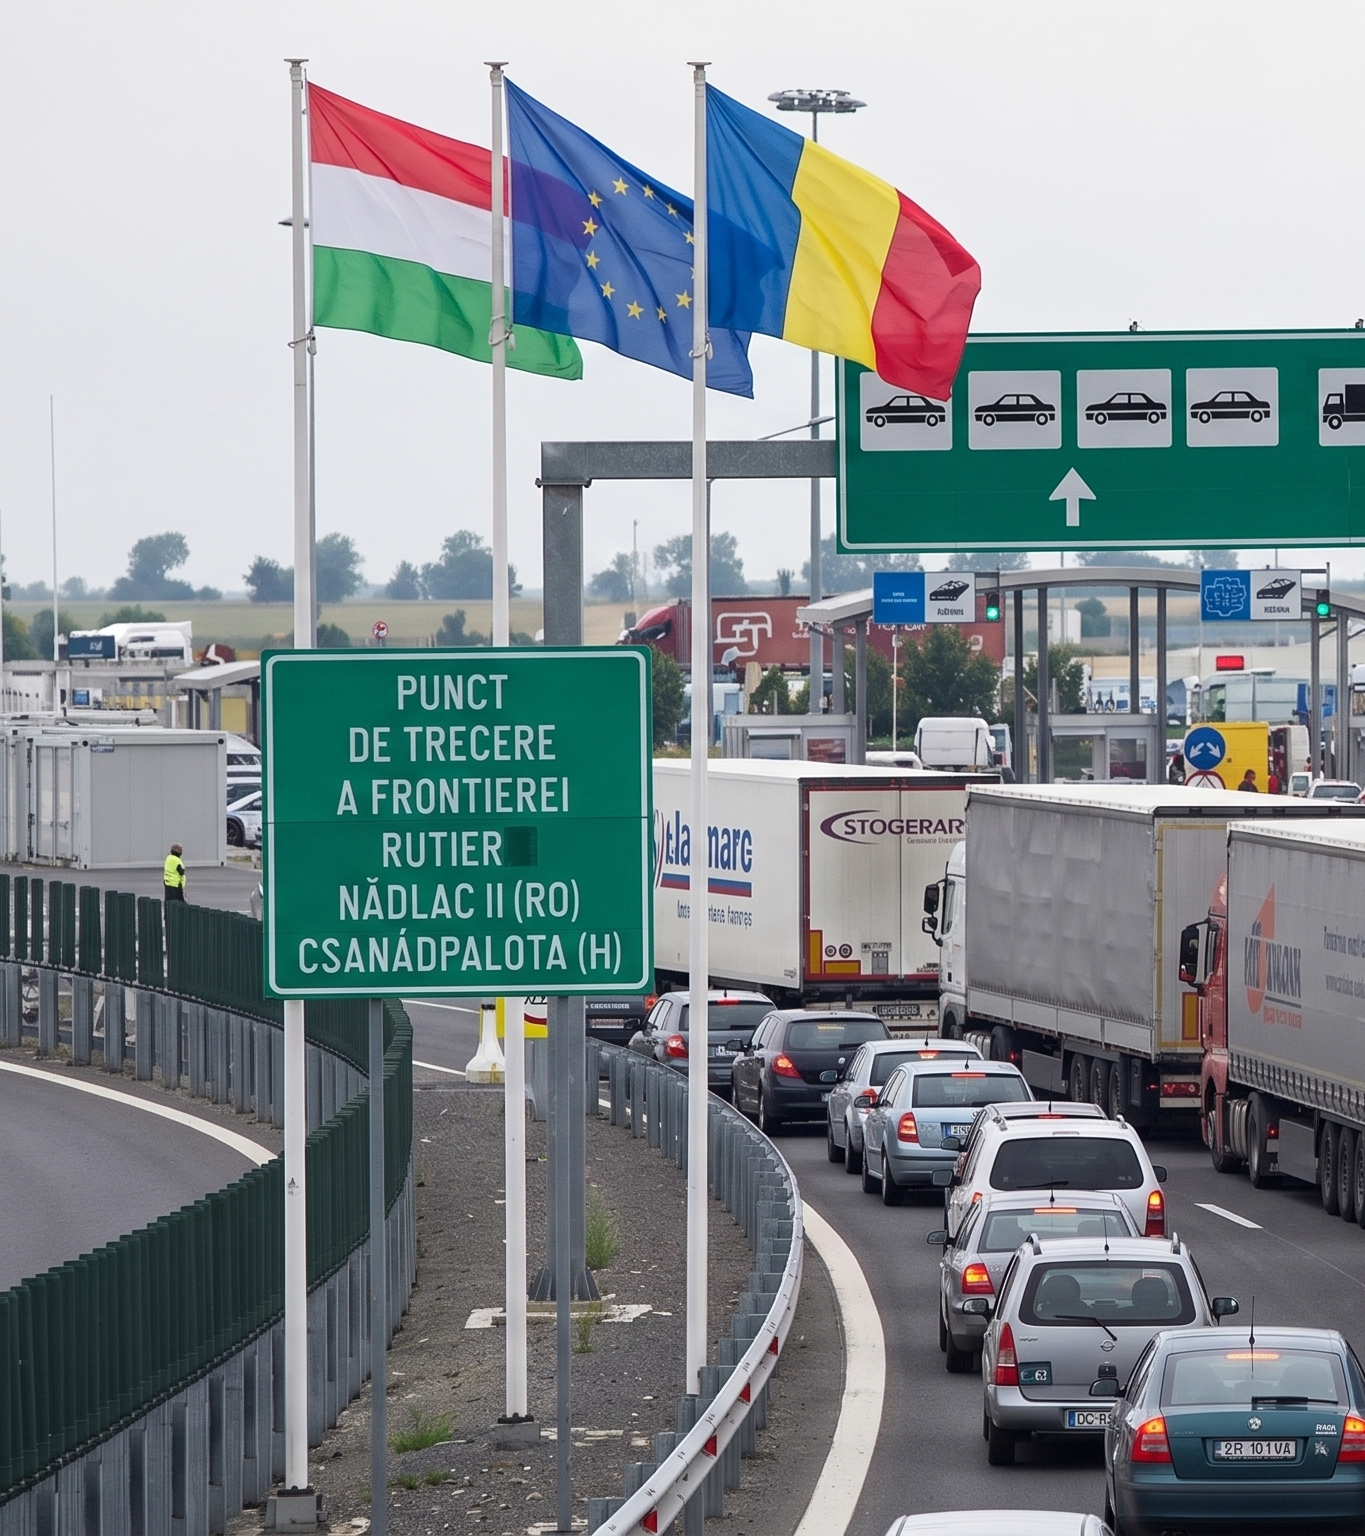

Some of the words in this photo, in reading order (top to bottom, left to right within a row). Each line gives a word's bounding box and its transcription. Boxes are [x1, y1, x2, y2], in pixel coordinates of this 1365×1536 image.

[397, 674, 508, 710] PUNCT
[349, 727, 391, 763] DE
[404, 725, 556, 762] TRECERE
[337, 780, 358, 815] A
[372, 777, 569, 815] FRONTIEREI
[339, 877, 474, 920] NĂDLAC
[487, 883, 503, 918] II
[514, 879, 580, 923] (RO)
[299, 928, 567, 974] CSANÁDPALOTA
[579, 931, 621, 975] (H)
